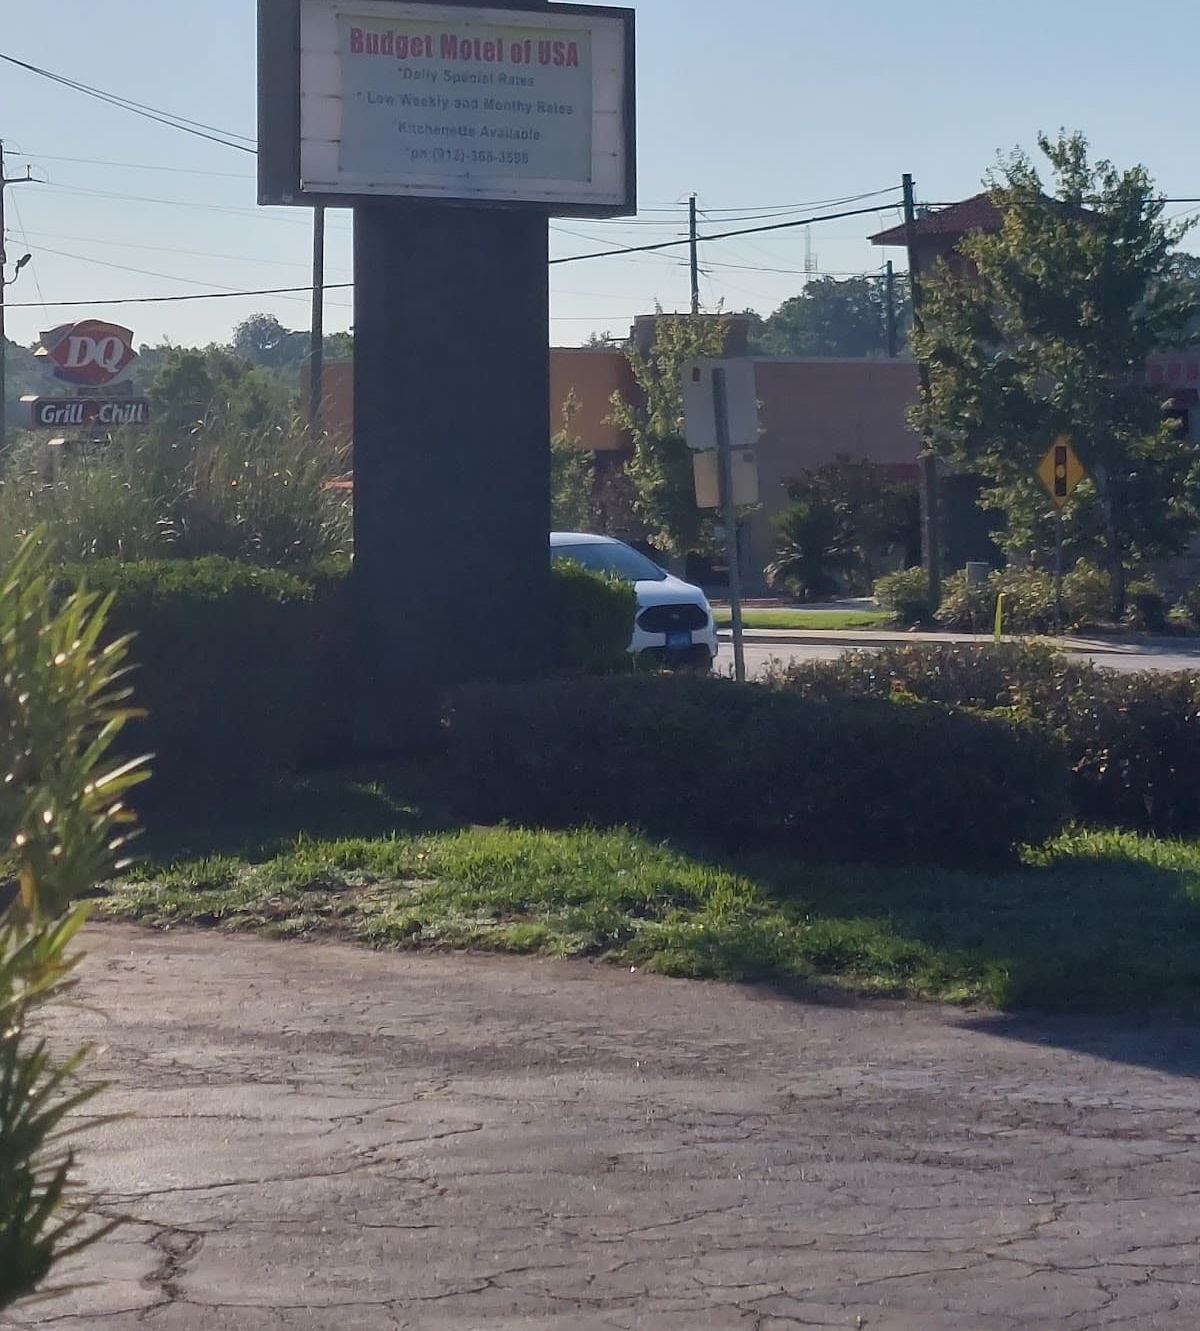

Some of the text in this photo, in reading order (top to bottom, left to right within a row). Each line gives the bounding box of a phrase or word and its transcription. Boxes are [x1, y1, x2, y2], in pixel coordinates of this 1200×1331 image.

[350, 27, 578, 66] Budget Motel of USA
[367, 90, 394, 105] Low
[400, 93, 448, 111] Weekly
[454, 98, 479, 109] and
[536, 101, 573, 115] Rates
[480, 124, 541, 141] Available
[64, 336, 124, 372] DQ
[41, 404, 83, 424] Grill
[99, 403, 144, 424] Chill
